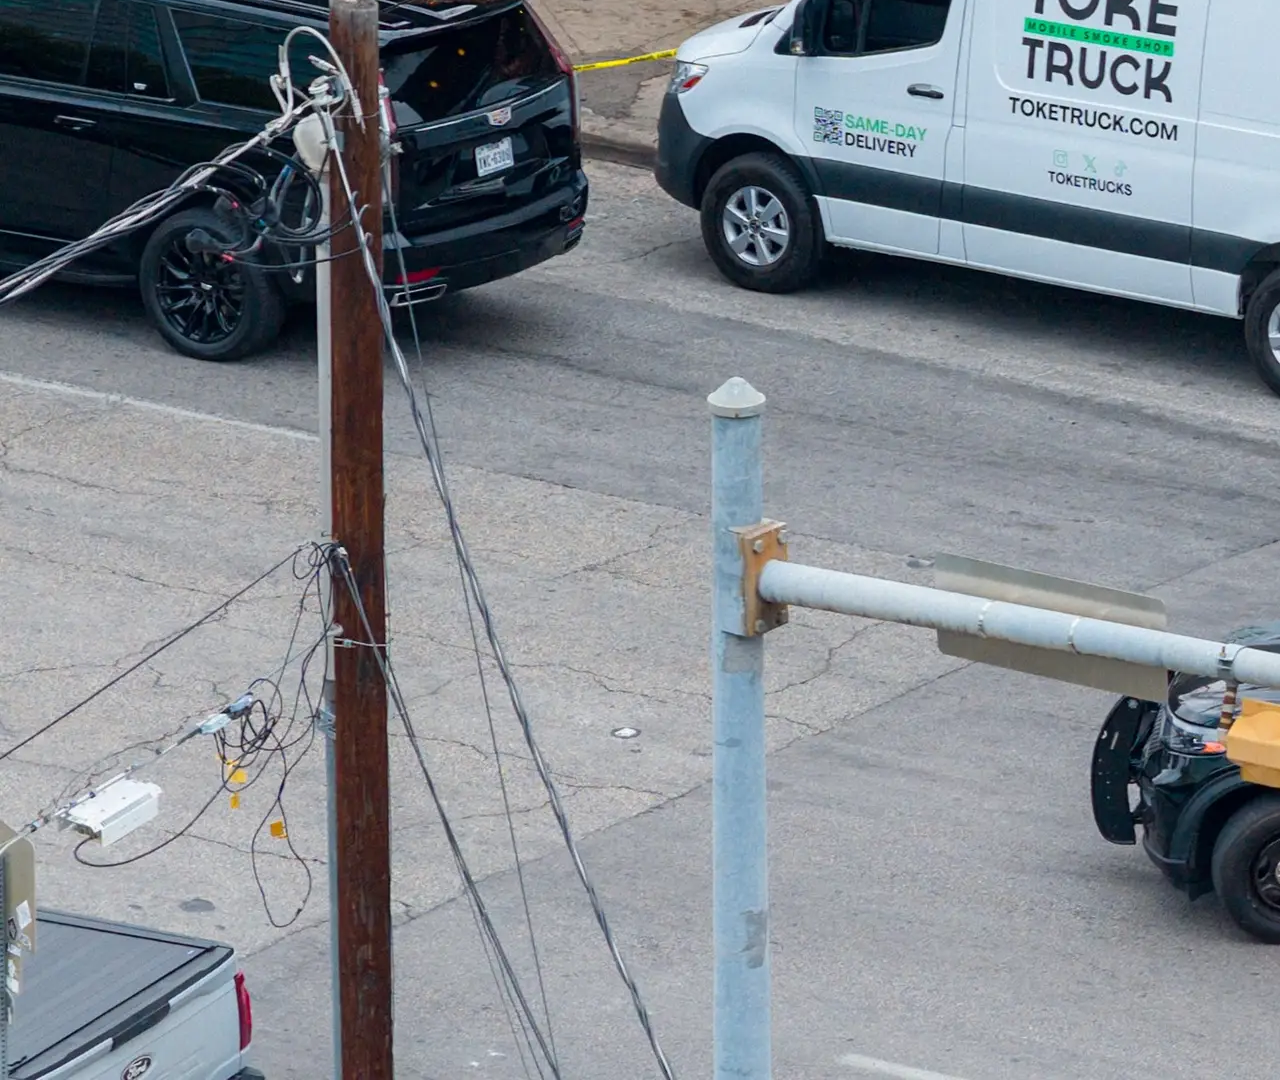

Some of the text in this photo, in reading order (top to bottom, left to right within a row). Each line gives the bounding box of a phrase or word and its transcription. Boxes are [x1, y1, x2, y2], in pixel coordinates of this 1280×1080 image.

[1027, 20, 1171, 54] MOBILE SMOKE SHOP
[1022, 37, 1172, 103] TRUCK
[845, 114, 927, 140] SAME-DAY
[1009, 96, 1178, 141] TOKETRUCK.COM
[845, 132, 916, 158] DELIVERY
[1048, 171, 1132, 196] TOKETRUCKS
